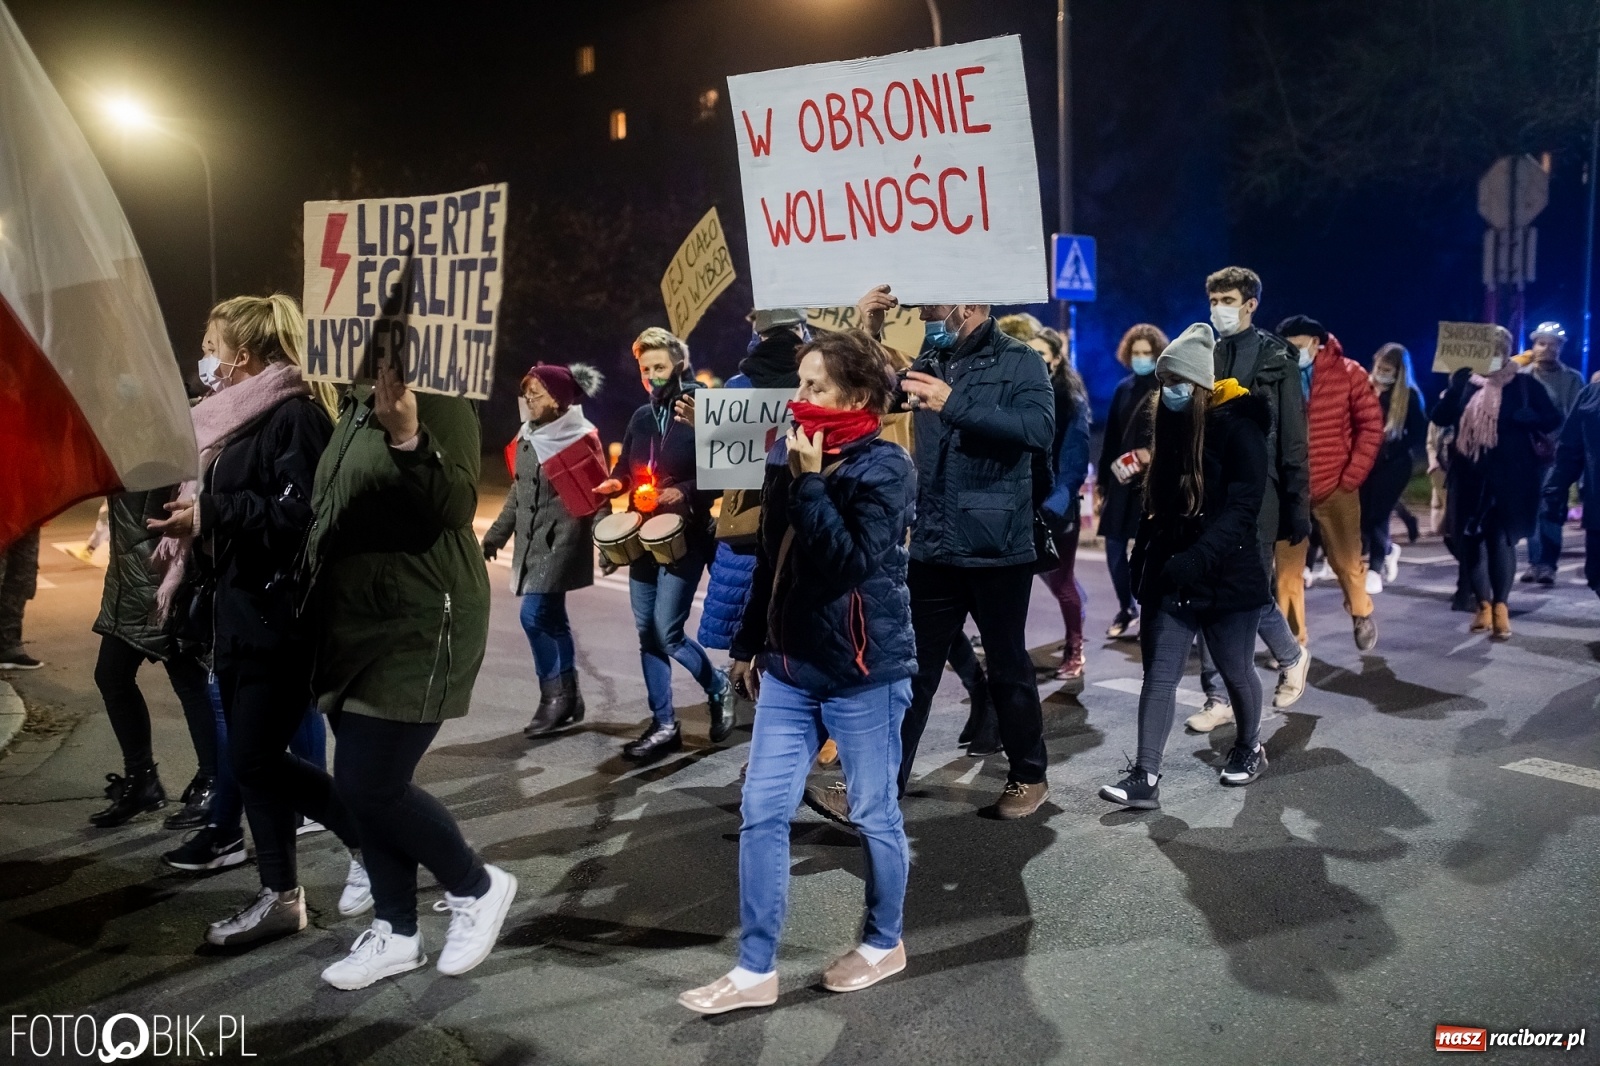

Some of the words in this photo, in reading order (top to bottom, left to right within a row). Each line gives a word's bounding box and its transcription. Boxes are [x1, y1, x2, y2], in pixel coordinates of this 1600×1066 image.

[741, 108, 773, 157] W
[798, 65, 992, 153] OBRONIE
[760, 154, 990, 248] WOLNOŚCI
[307, 318, 492, 395] WYPIERDALAJTE
[709, 439, 770, 469] POL
